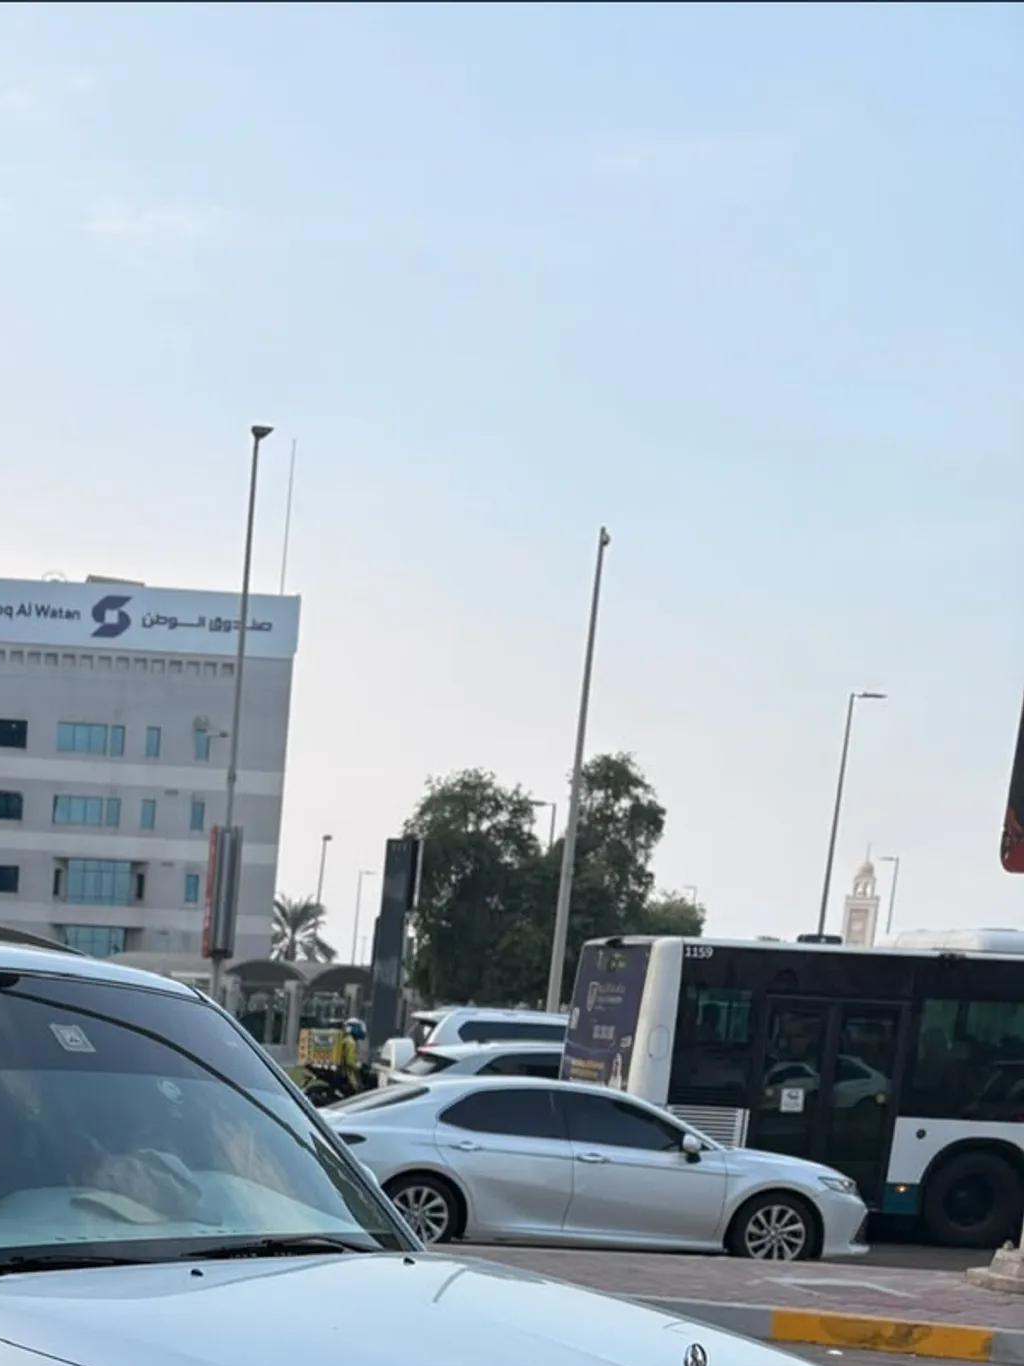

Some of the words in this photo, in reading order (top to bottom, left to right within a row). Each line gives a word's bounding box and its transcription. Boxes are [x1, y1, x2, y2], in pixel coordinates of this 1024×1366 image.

[16, 602, 33, 618] Al
[35, 602, 81, 621] Watan
[141, 611, 206, 631] الوطن
[685, 946, 713, 959] 1159
